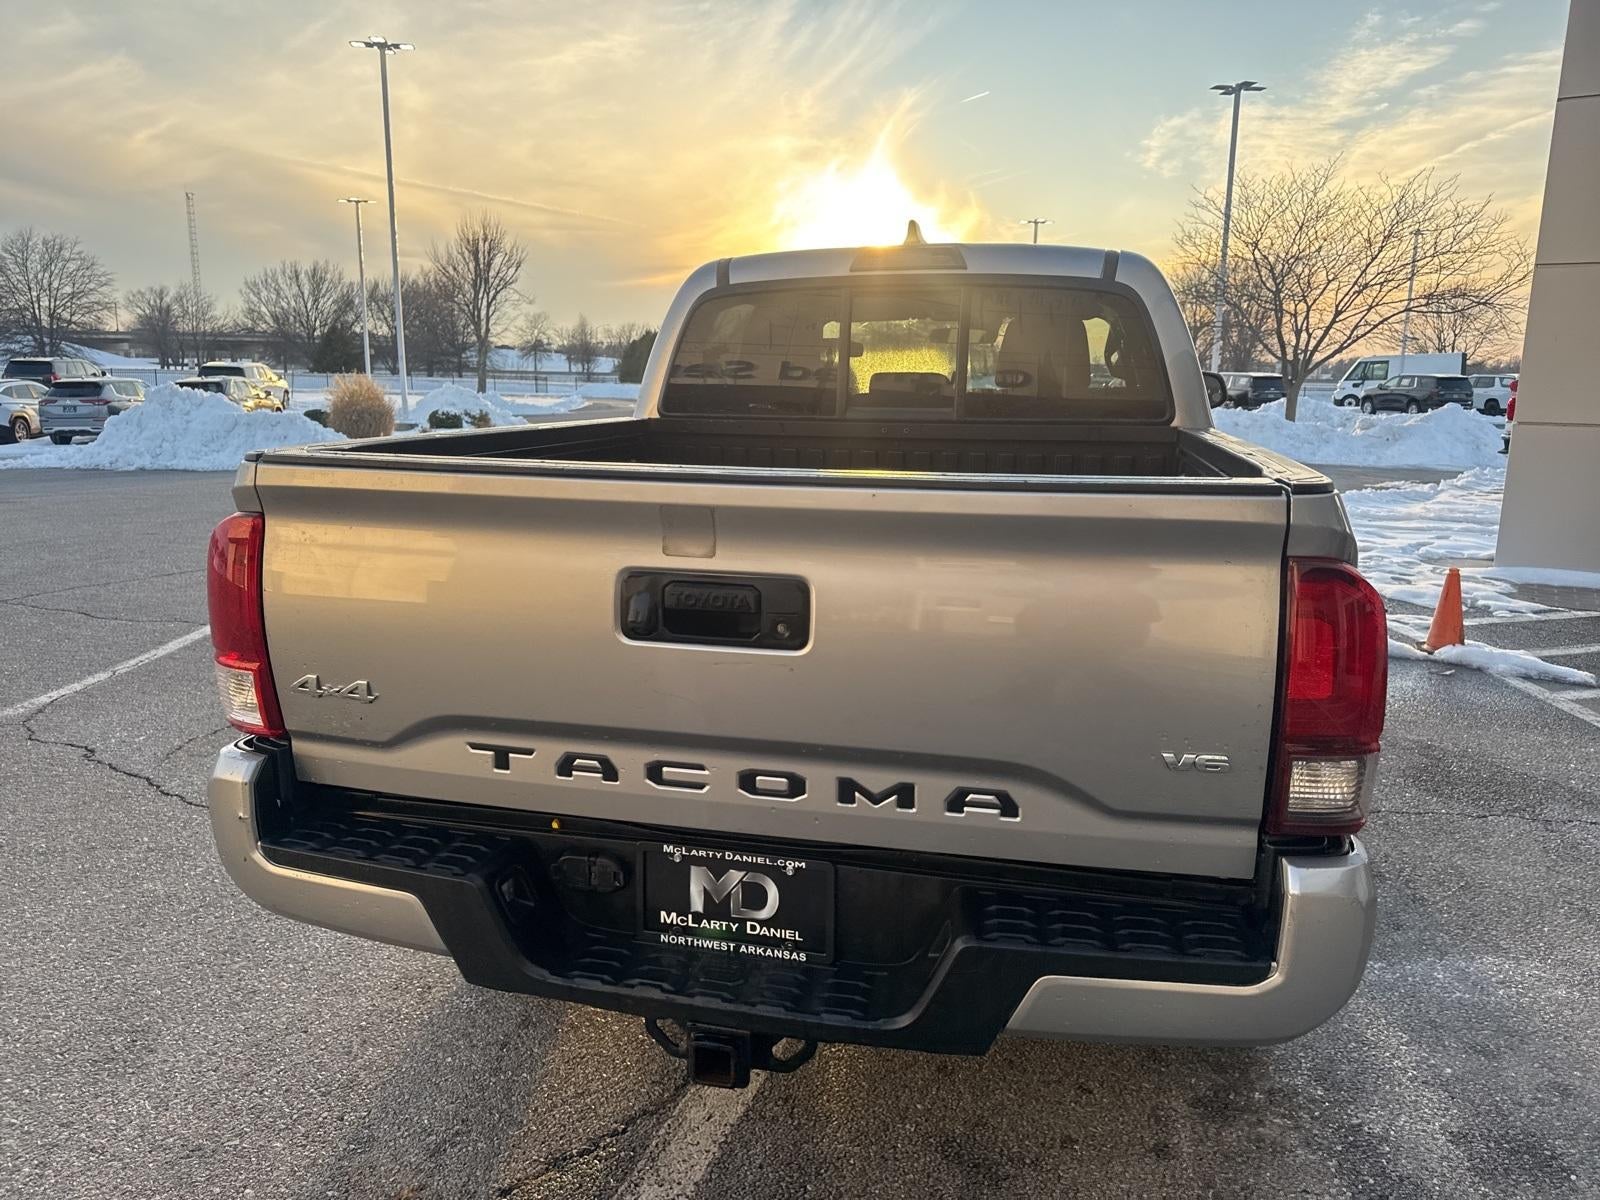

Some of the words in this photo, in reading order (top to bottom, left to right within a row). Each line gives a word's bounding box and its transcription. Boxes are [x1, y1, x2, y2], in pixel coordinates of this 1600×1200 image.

[672, 591, 753, 611] TOYOTA
[1161, 752, 1230, 773] V6
[466, 741, 1021, 821] TACOMA
[689, 865, 780, 921] MD
[746, 921, 804, 941] DANIEL
[660, 934, 736, 952] NORTHWEST
[739, 945, 807, 962] ARKANSAS
